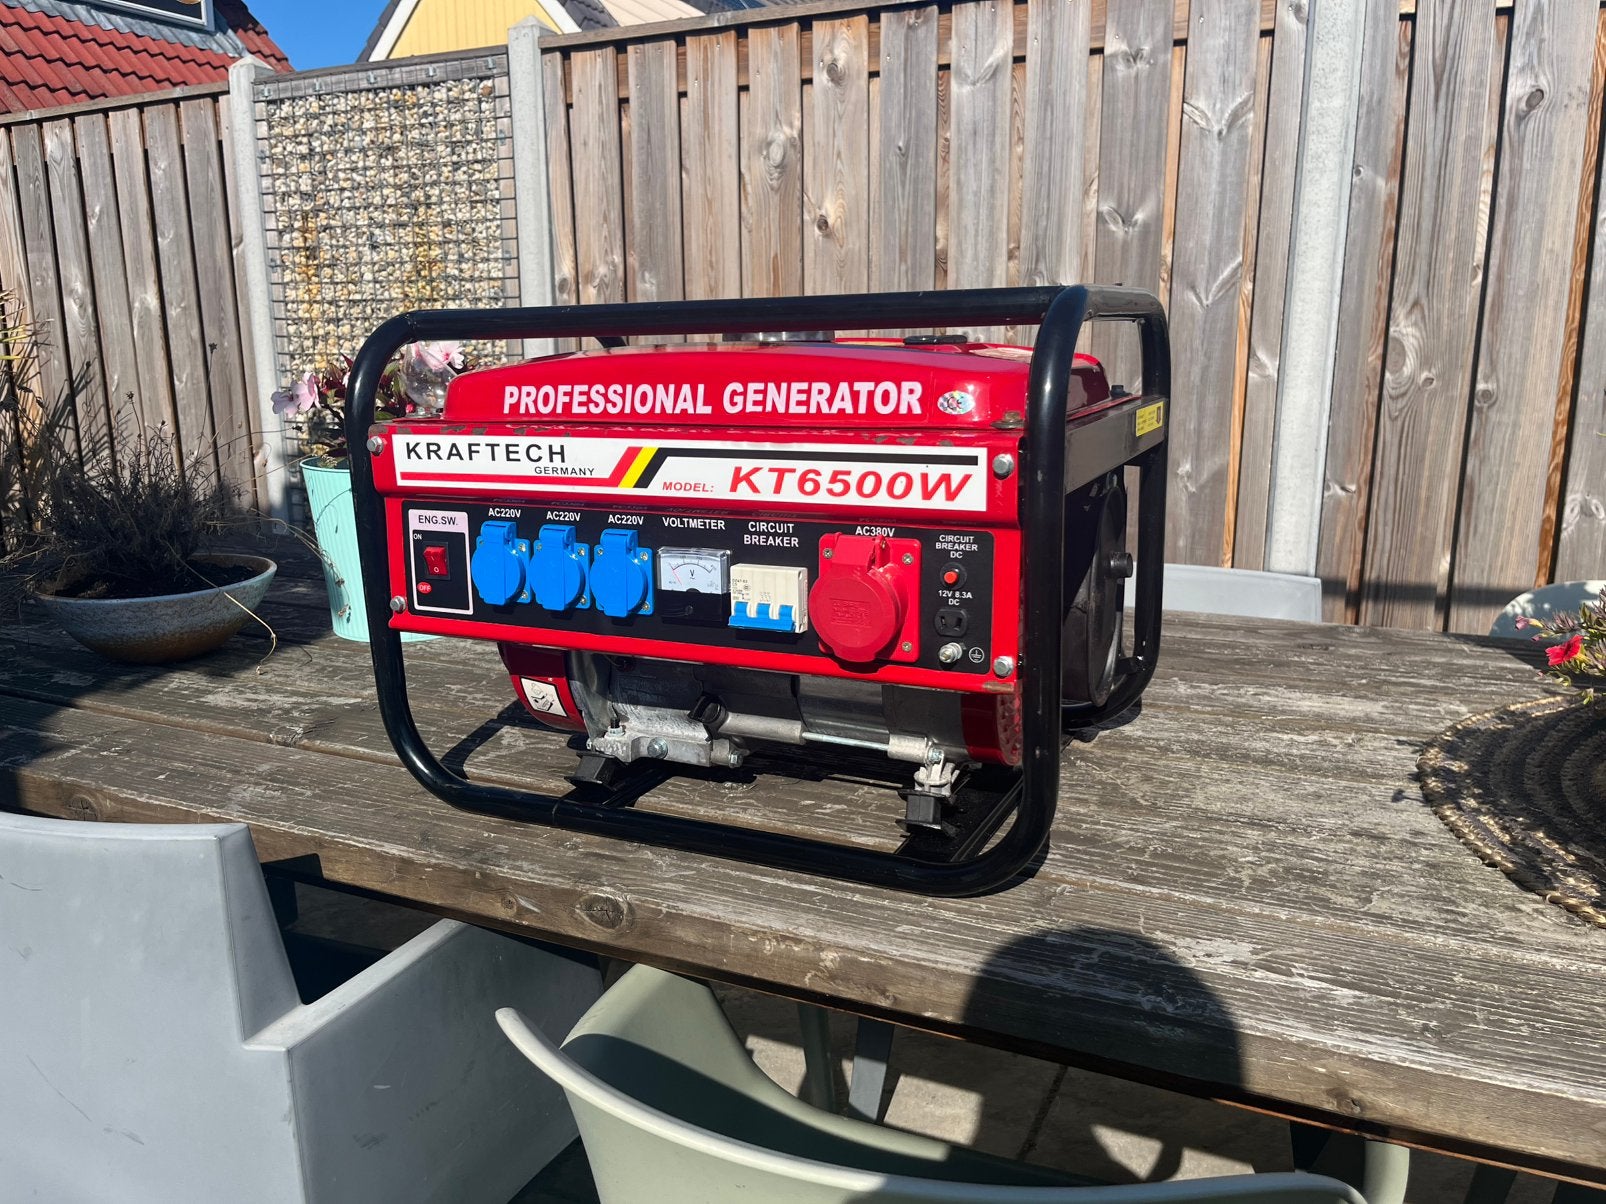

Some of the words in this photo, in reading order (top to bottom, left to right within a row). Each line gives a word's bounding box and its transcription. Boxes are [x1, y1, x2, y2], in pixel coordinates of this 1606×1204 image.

[503, 384, 713, 415] PROFESSIONAL
[722, 381, 923, 415] GENERATOR
[405, 441, 566, 463] KRAFTECH
[534, 466, 595, 477] GERMANY
[662, 481, 715, 493] MODEL:
[729, 466, 973, 502] KT6500W
[488, 507, 521, 518] AC220V
[546, 510, 581, 522] AC220V
[608, 514, 644, 525] AC220V
[662, 516, 726, 530] VOLTMETER
[748, 521, 795, 534] CIRCUIT
[855, 525, 896, 538] AC380V
[743, 534, 799, 548] BREAKER
[939, 534, 975, 543] CIRCUIT
[935, 542, 978, 552] BREAKER
[949, 550, 964, 559] DC
[418, 584, 431, 592] OFF
[938, 590, 952, 598] 12V
[954, 591, 973, 599] 8.3A
[948, 598, 961, 606] DC
